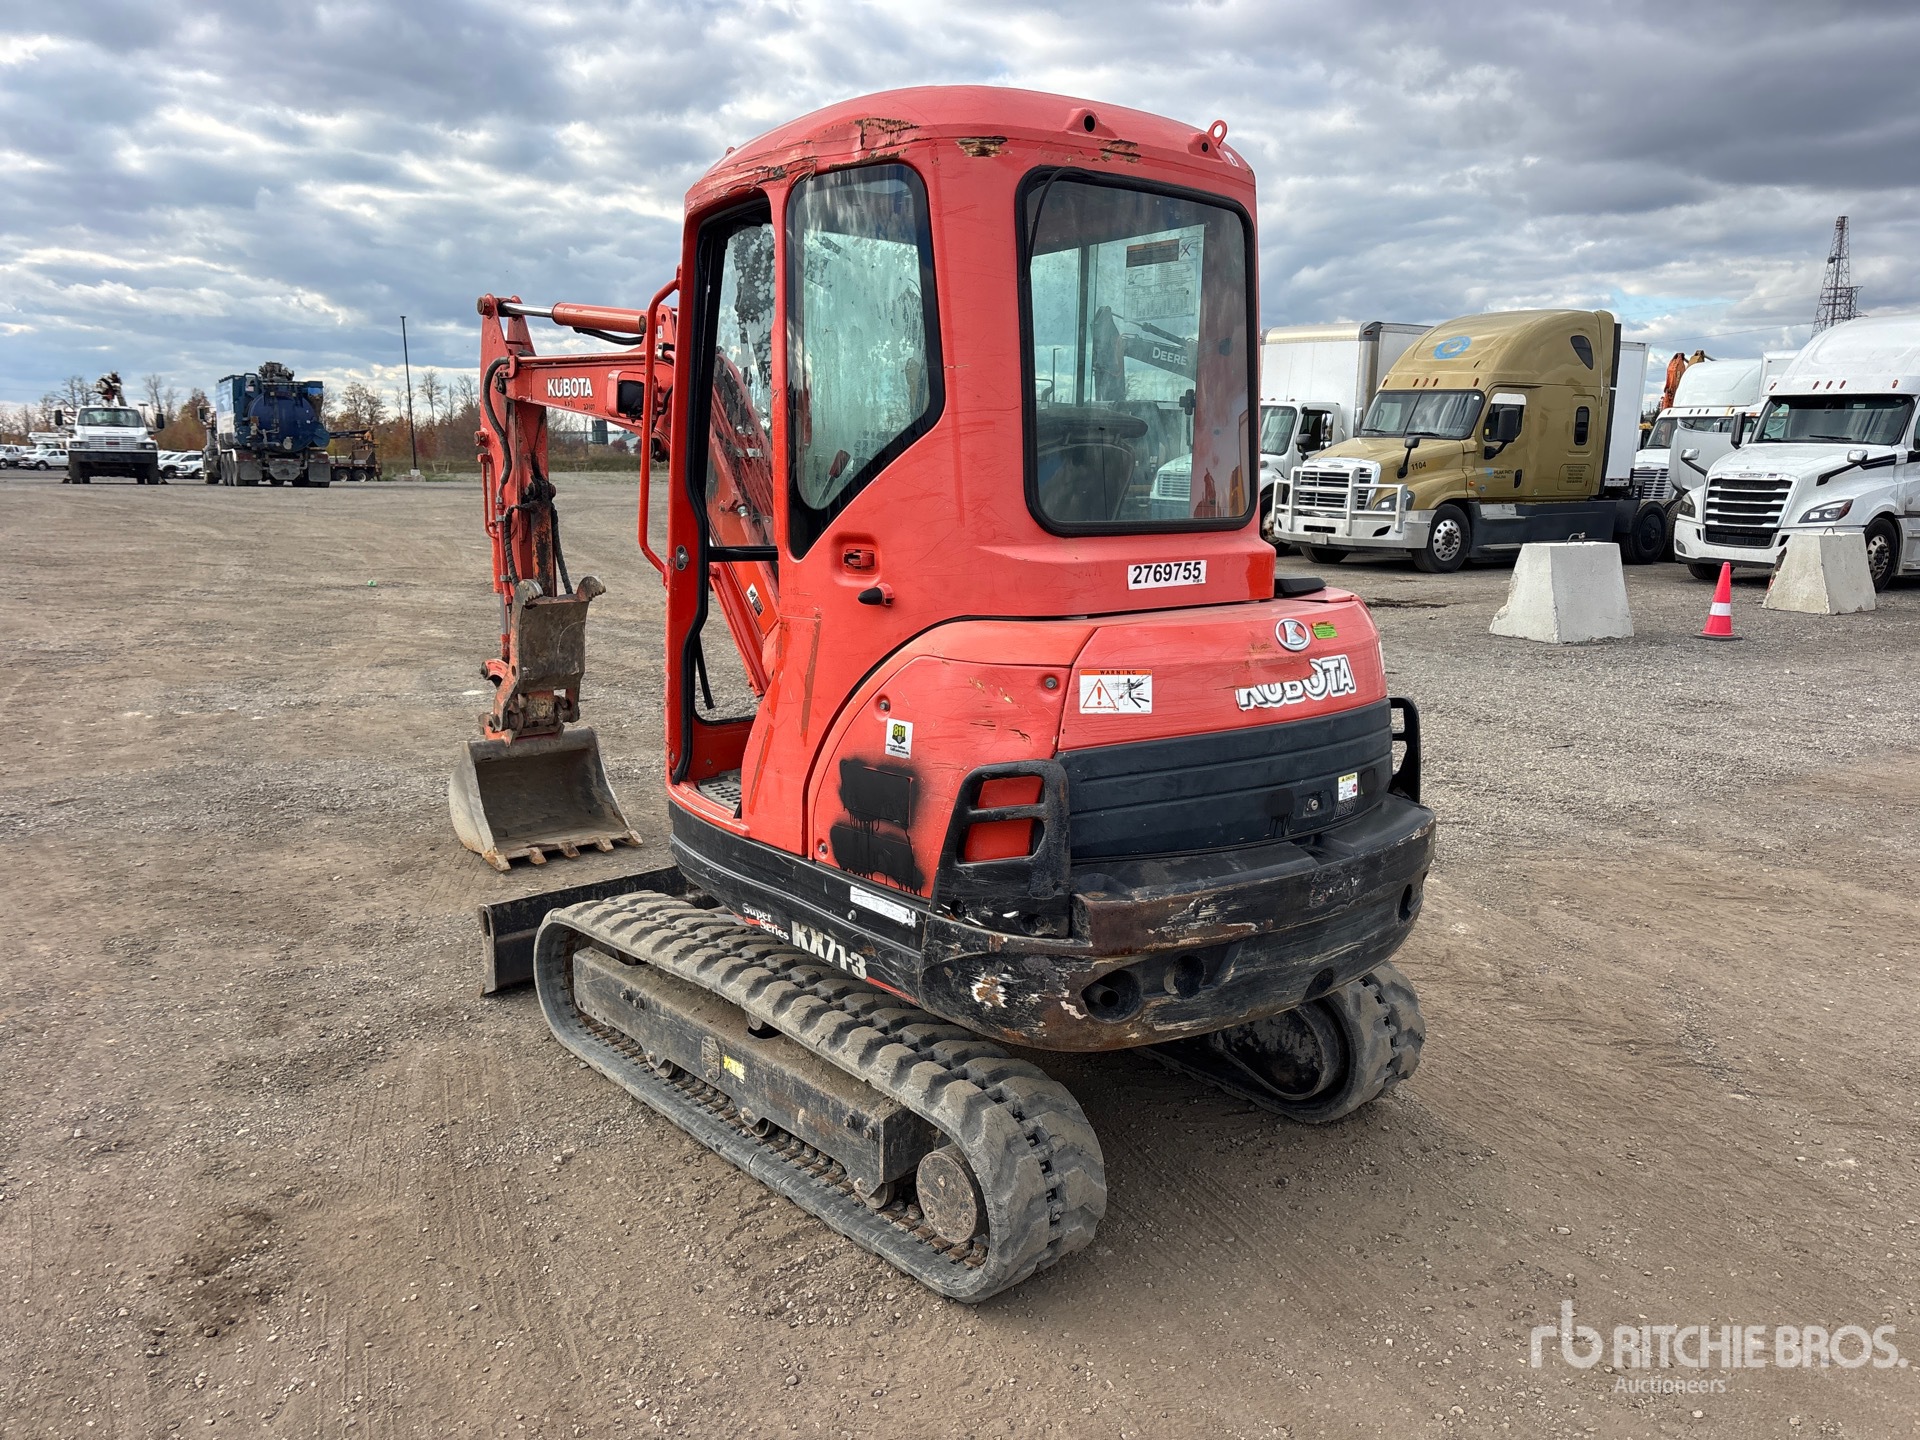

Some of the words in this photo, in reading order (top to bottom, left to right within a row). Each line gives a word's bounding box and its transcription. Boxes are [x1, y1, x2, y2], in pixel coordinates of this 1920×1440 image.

[1152, 346, 1187, 366] DEERE
[547, 377, 593, 397] KUBOTA
[1411, 462, 1427, 470] 1104
[1132, 561, 1202, 584] 2769755
[893, 724, 906, 737] 811
[741, 902, 772, 922] Super
[759, 920, 790, 941] Series
[791, 920, 868, 980] KX71-3
